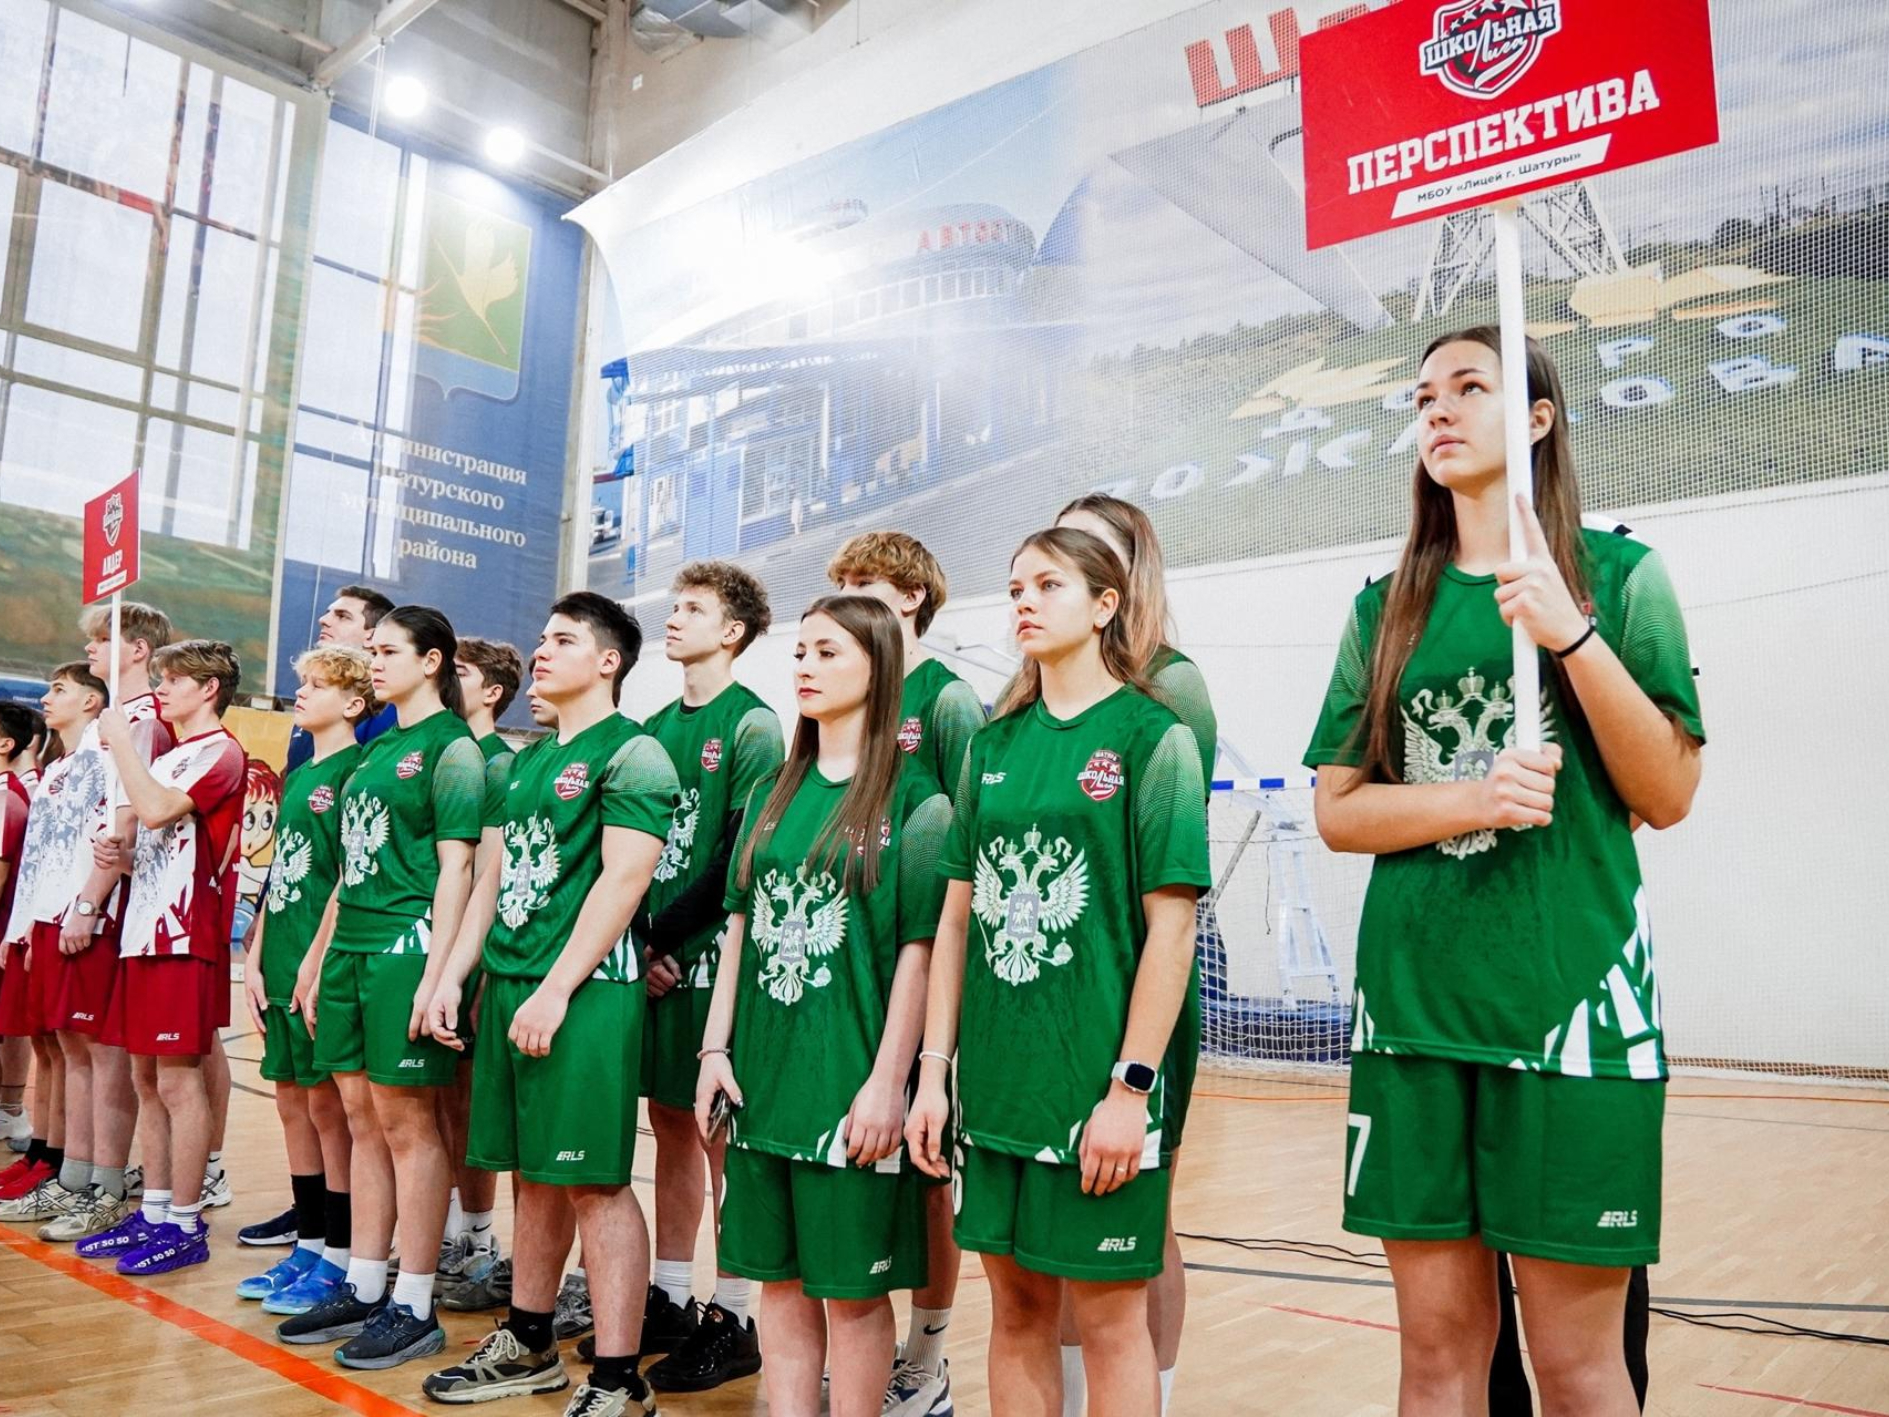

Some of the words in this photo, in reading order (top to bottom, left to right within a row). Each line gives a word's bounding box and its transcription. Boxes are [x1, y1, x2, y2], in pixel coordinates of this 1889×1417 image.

[1425, 6, 1554, 70] ШКОЛЬНАЯ
[1347, 69, 1660, 195] ПЕРСПЕКТИВА
[1417, 186, 1453, 203] МБОУ
[1457, 173, 1502, 191] «Лицей
[1506, 170, 1515, 179] г.
[1519, 152, 1581, 175] Шатуры»
[398, 537, 477, 569] района
[1346, 1112, 1372, 1197] 7
